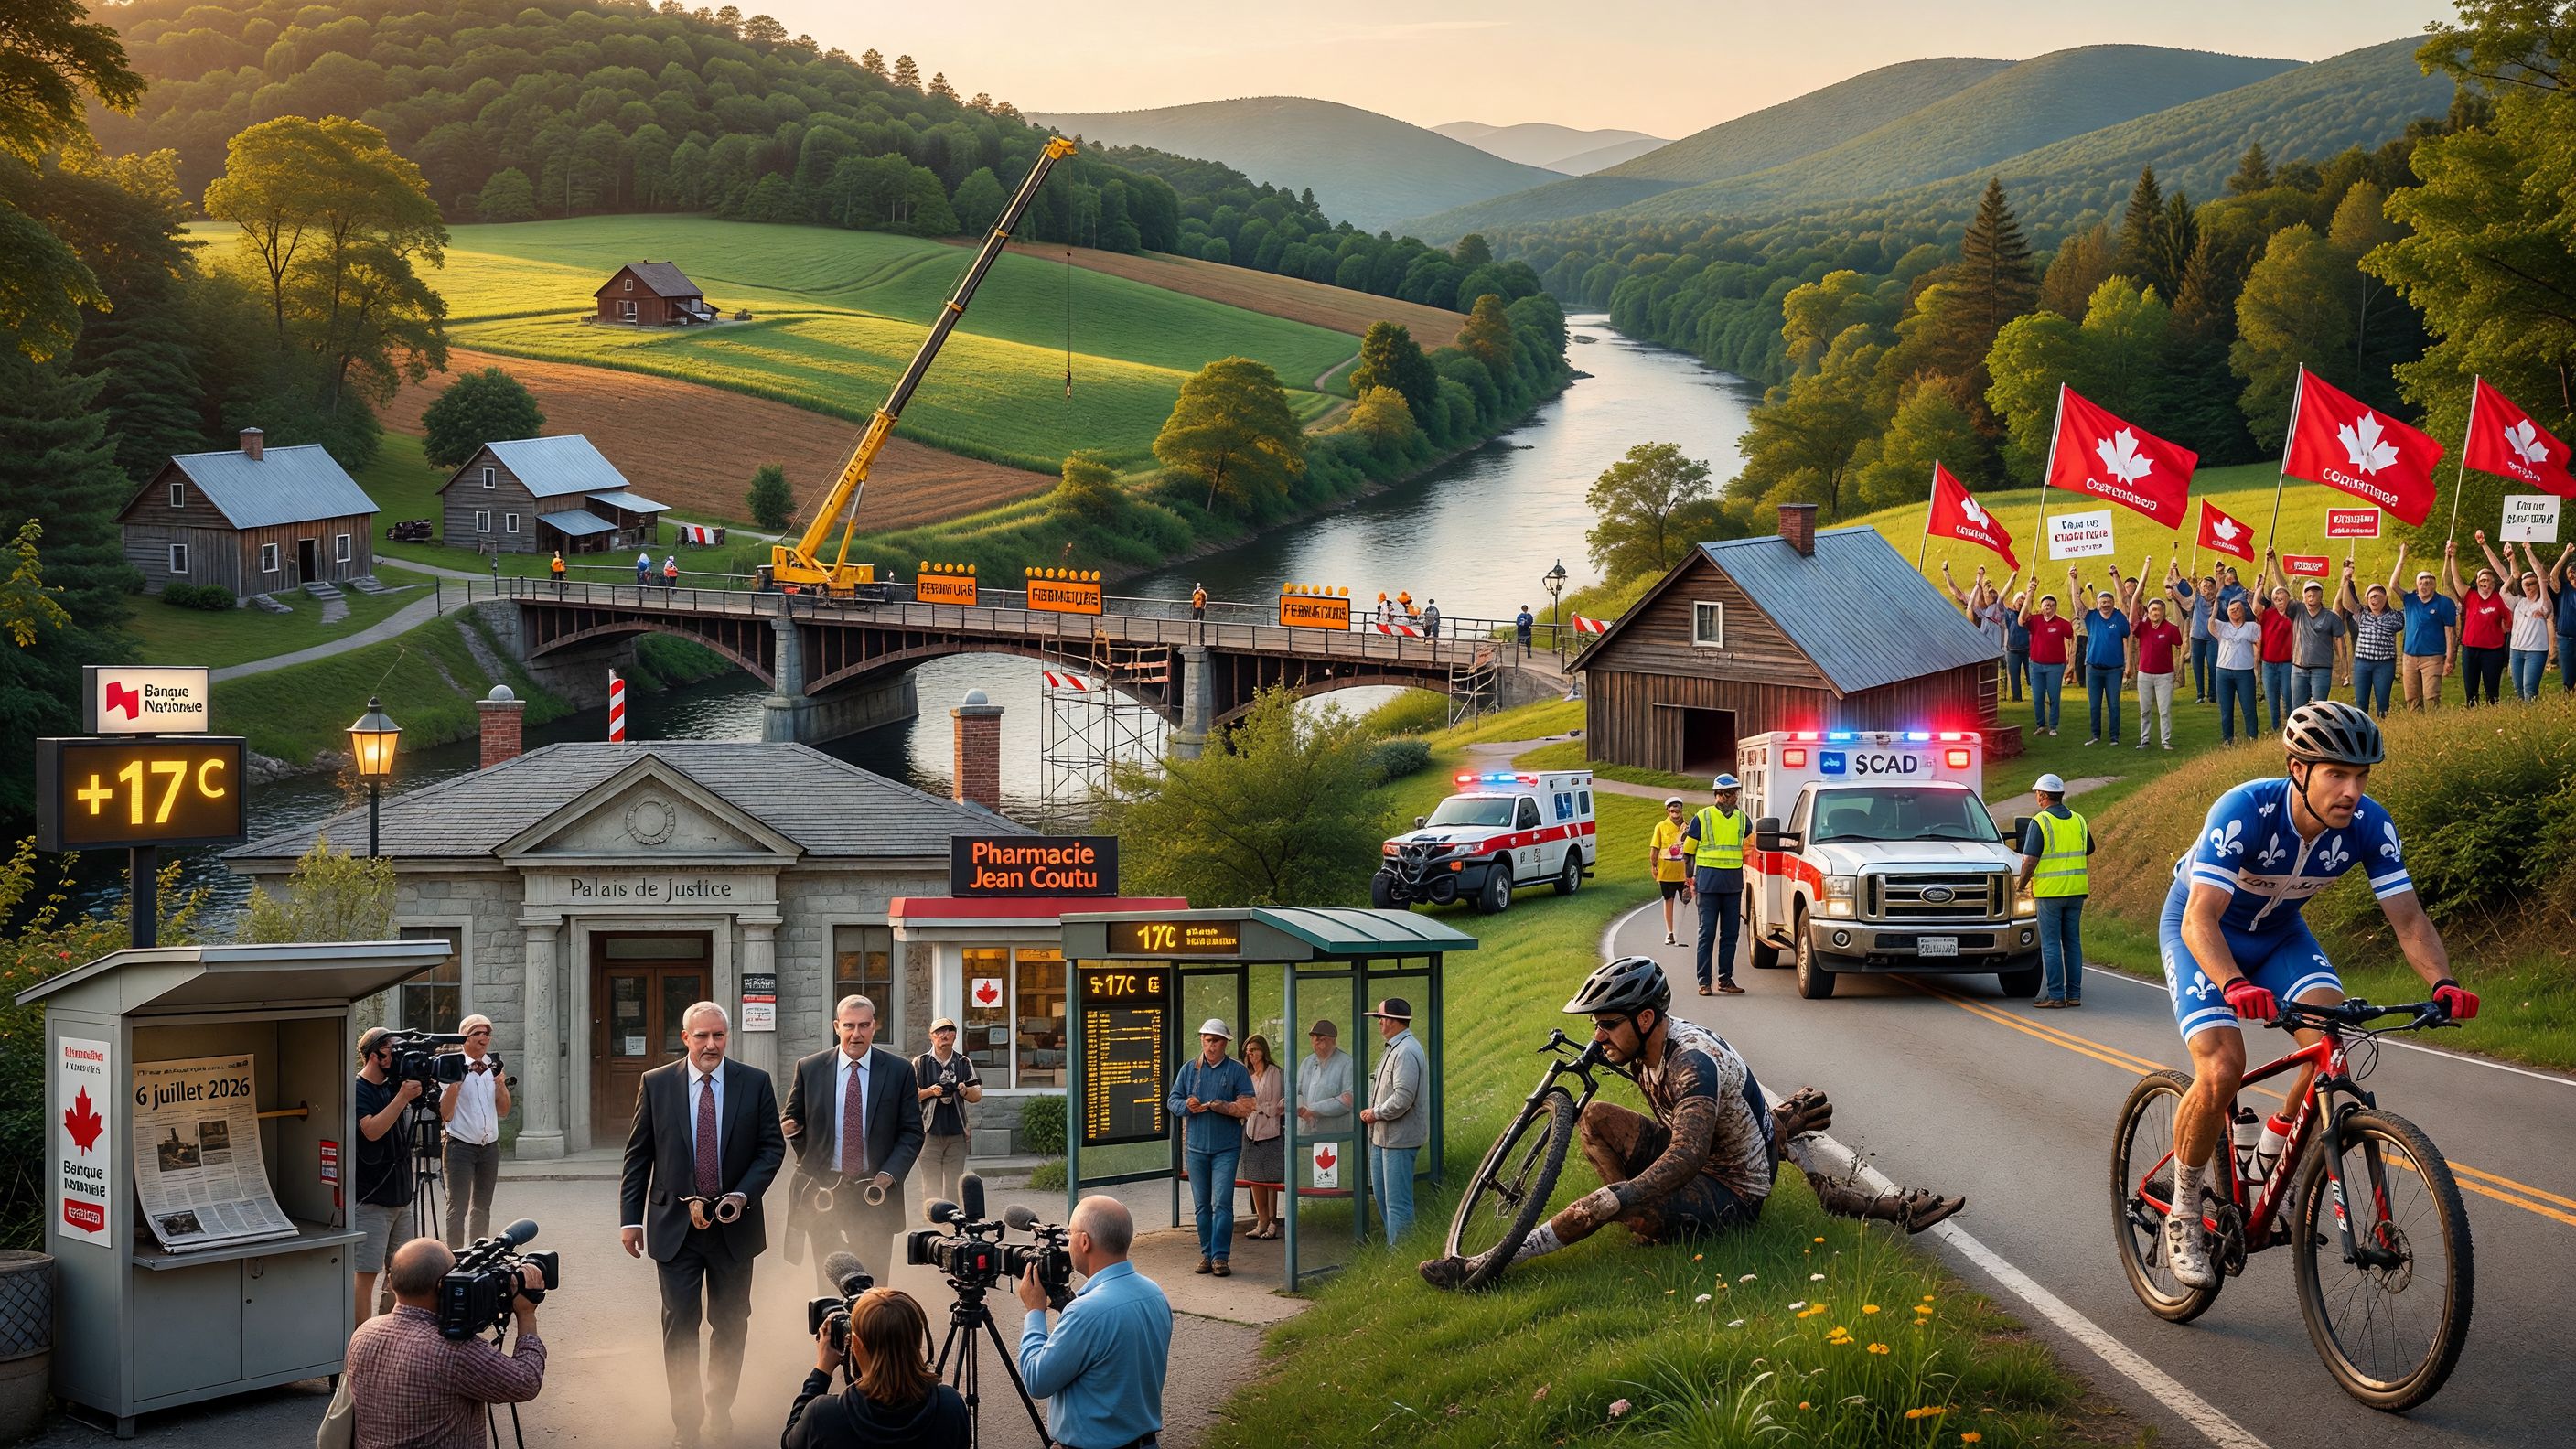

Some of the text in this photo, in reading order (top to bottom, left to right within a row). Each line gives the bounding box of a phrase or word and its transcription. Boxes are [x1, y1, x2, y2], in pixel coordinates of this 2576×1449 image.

[145, 683, 189, 701] Banque
[1855, 753, 1918, 775] SCAD
[971, 842, 1095, 864] Pharmacie
[970, 866, 1098, 888] Jean Coutu
[571, 877, 732, 903] Palais de Justice
[135, 1077, 250, 1111] 6 juillet 2026
